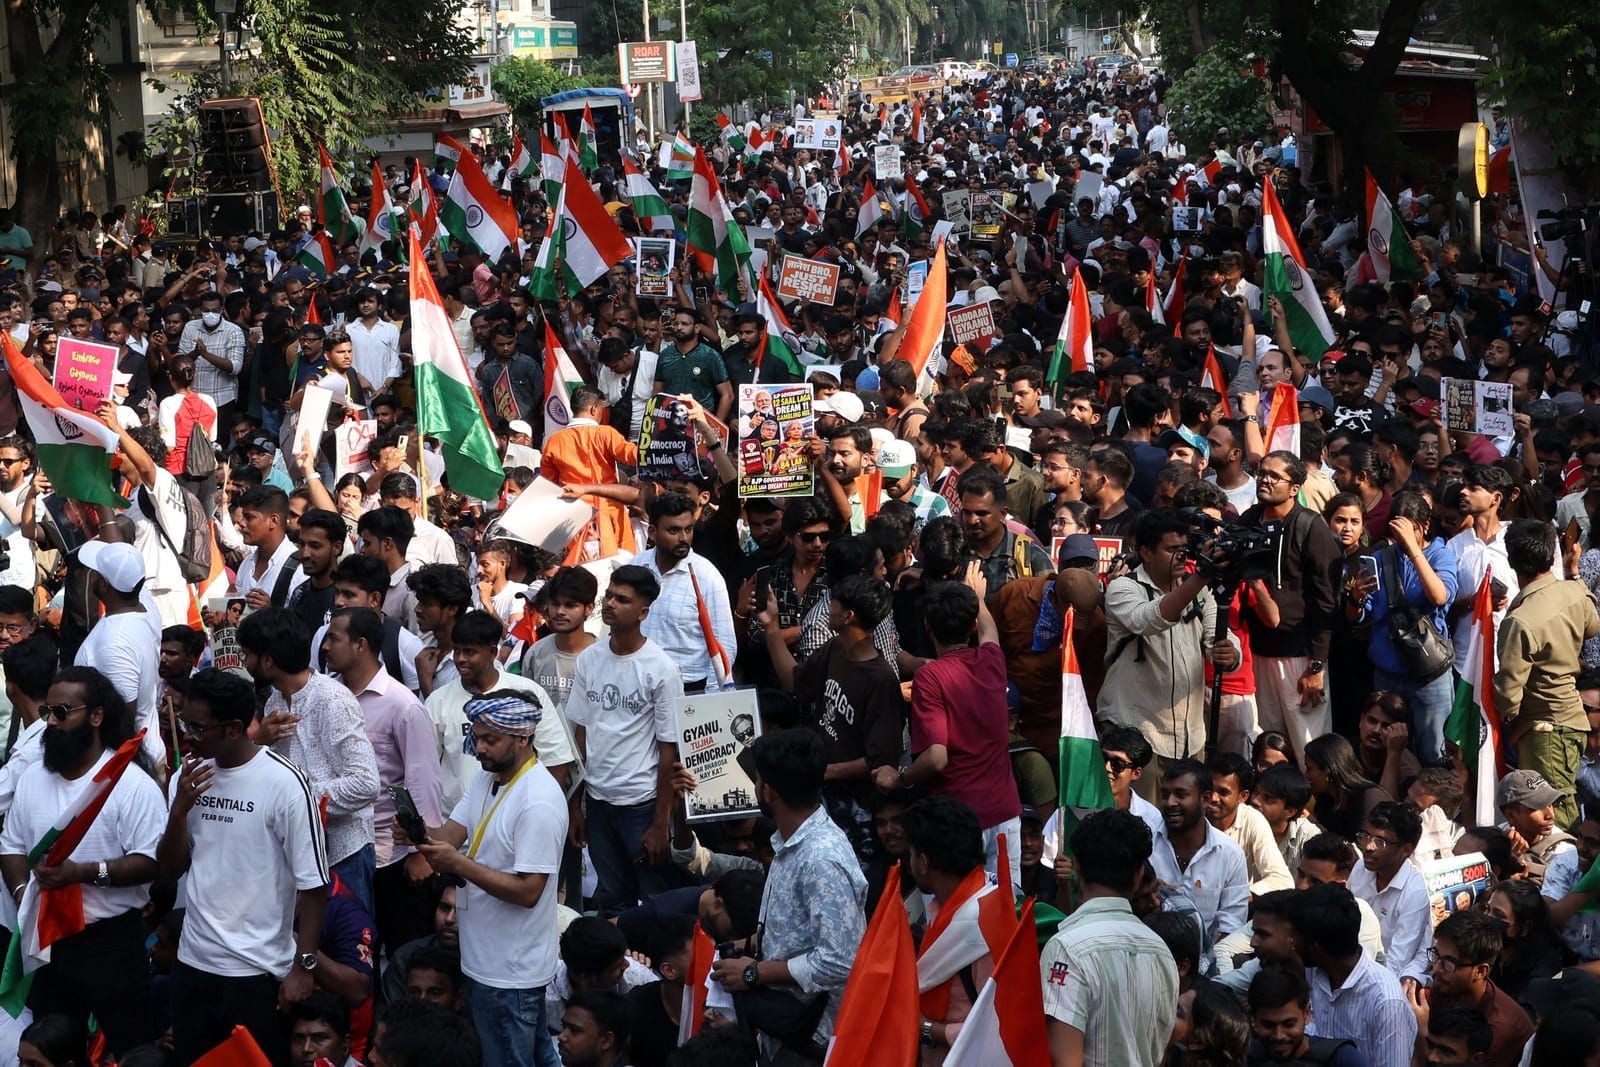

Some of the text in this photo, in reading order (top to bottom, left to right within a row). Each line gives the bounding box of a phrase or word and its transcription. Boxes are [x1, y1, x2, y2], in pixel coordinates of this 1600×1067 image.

[634, 46, 660, 57] ROAR
[790, 271, 827, 284] JUST
[810, 265, 832, 278] BRO,
[783, 277, 832, 295] RESIGN
[952, 307, 988, 324] GADDAAR
[956, 316, 990, 334] GYAANU
[956, 326, 992, 344] MUST GO
[72, 351, 100, 365] Embrace
[70, 366, 98, 382] Gayness
[645, 396, 672, 418] Murderer
[774, 394, 810, 408] 12 SAAL LAGA
[776, 402, 808, 414] DREAM 11
[642, 416, 655, 434] Of
[777, 412, 801, 422] GAMBLING
[639, 433, 686, 452] Democracy
[639, 450, 673, 466] In India
[780, 461, 790, 469] 84
[684, 720, 722, 743] GYANU,
[690, 736, 714, 751] TUJHA
[685, 742, 736, 768] DEMOCRACY
[693, 758, 728, 774] VAR BHAROSA
[700, 768, 722, 780] NAY KA?
[1430, 861, 1489, 892] COMING SOON!
